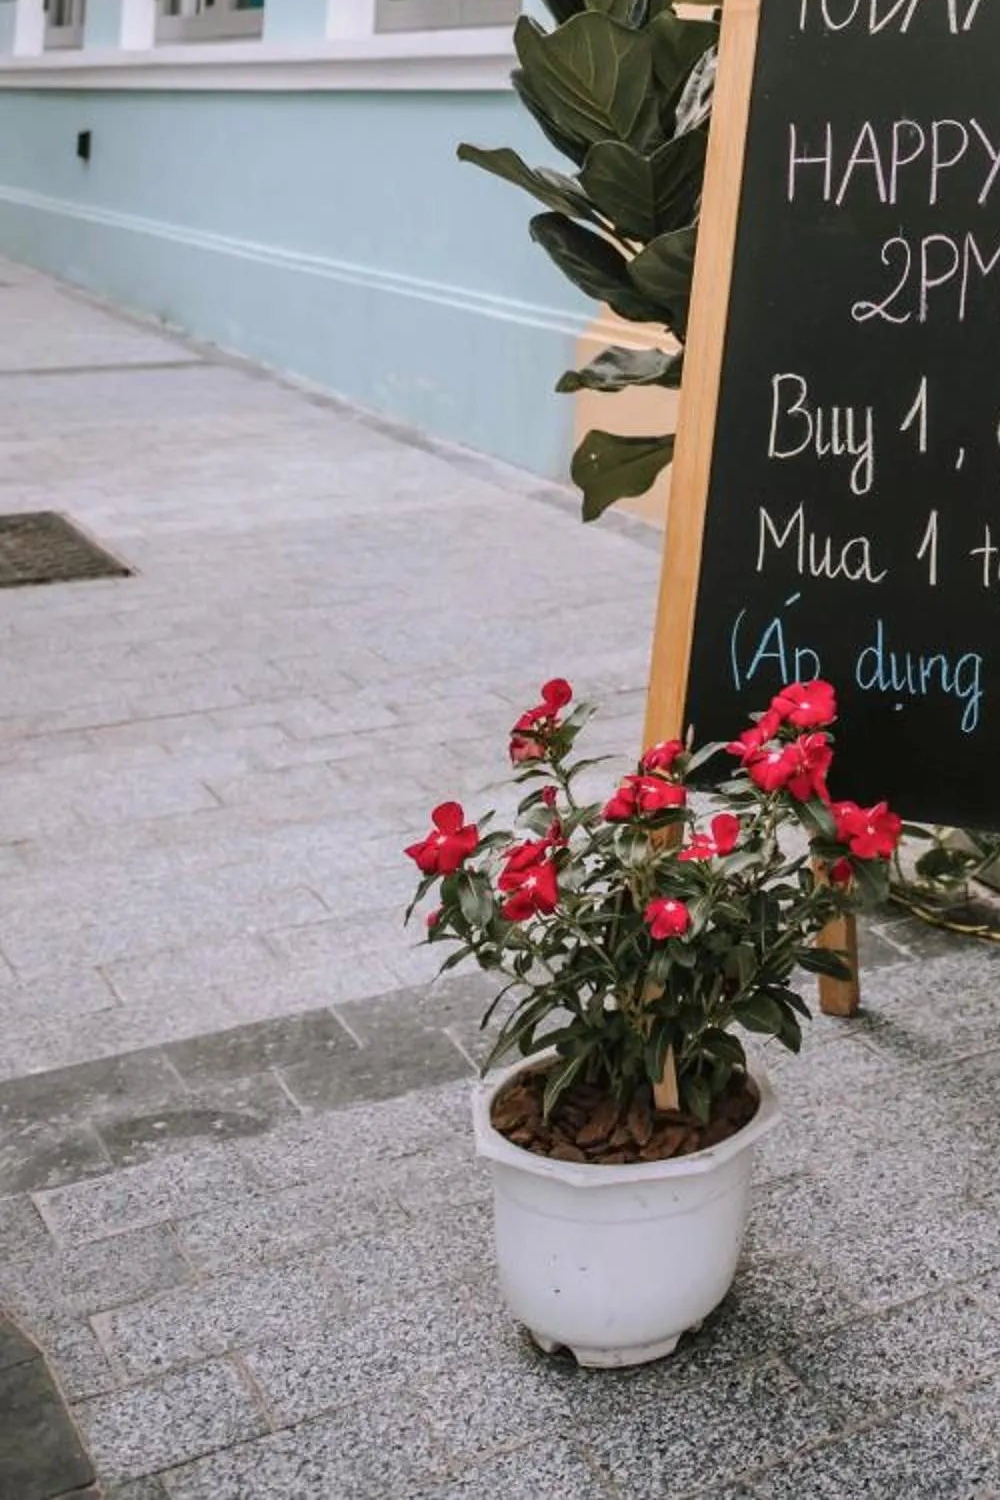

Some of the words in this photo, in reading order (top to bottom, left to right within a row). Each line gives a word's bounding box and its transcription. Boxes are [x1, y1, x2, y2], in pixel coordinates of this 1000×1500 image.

[768, 373, 873, 495] Buy
[757, 504, 887, 584] Mua
[917, 510, 937, 585] 1
[856, 620, 983, 732] dụng
